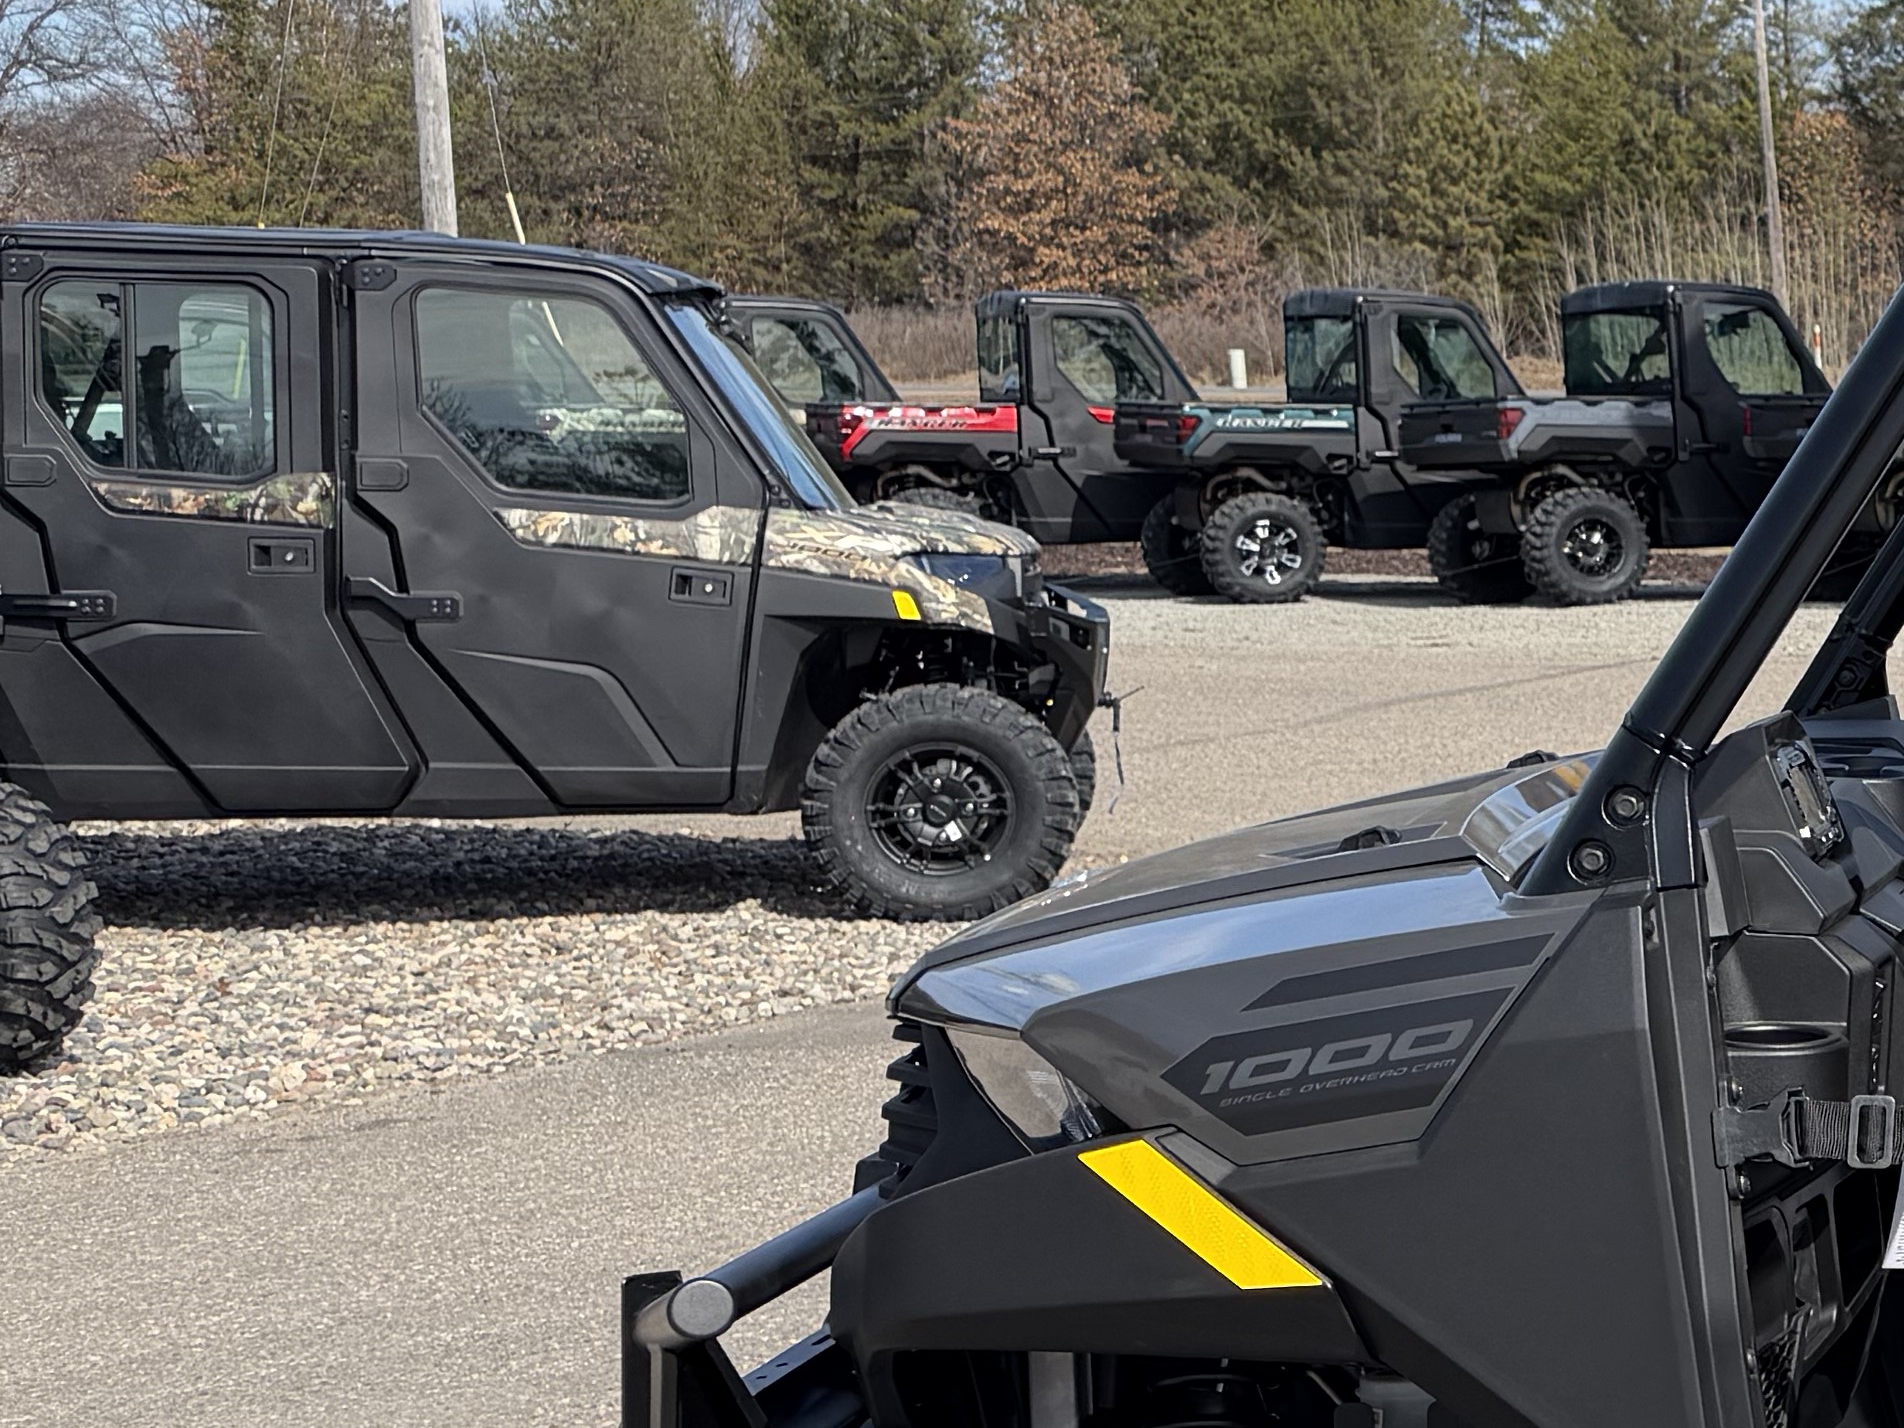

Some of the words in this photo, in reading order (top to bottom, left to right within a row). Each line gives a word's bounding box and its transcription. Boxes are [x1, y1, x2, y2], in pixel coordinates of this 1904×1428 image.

[1199, 1017, 1474, 1096] 1000
[1218, 1087, 1293, 1108] SINGLE
[1299, 1066, 1409, 1093] OVERHEAD
[1411, 1058, 1457, 1073] CAM
